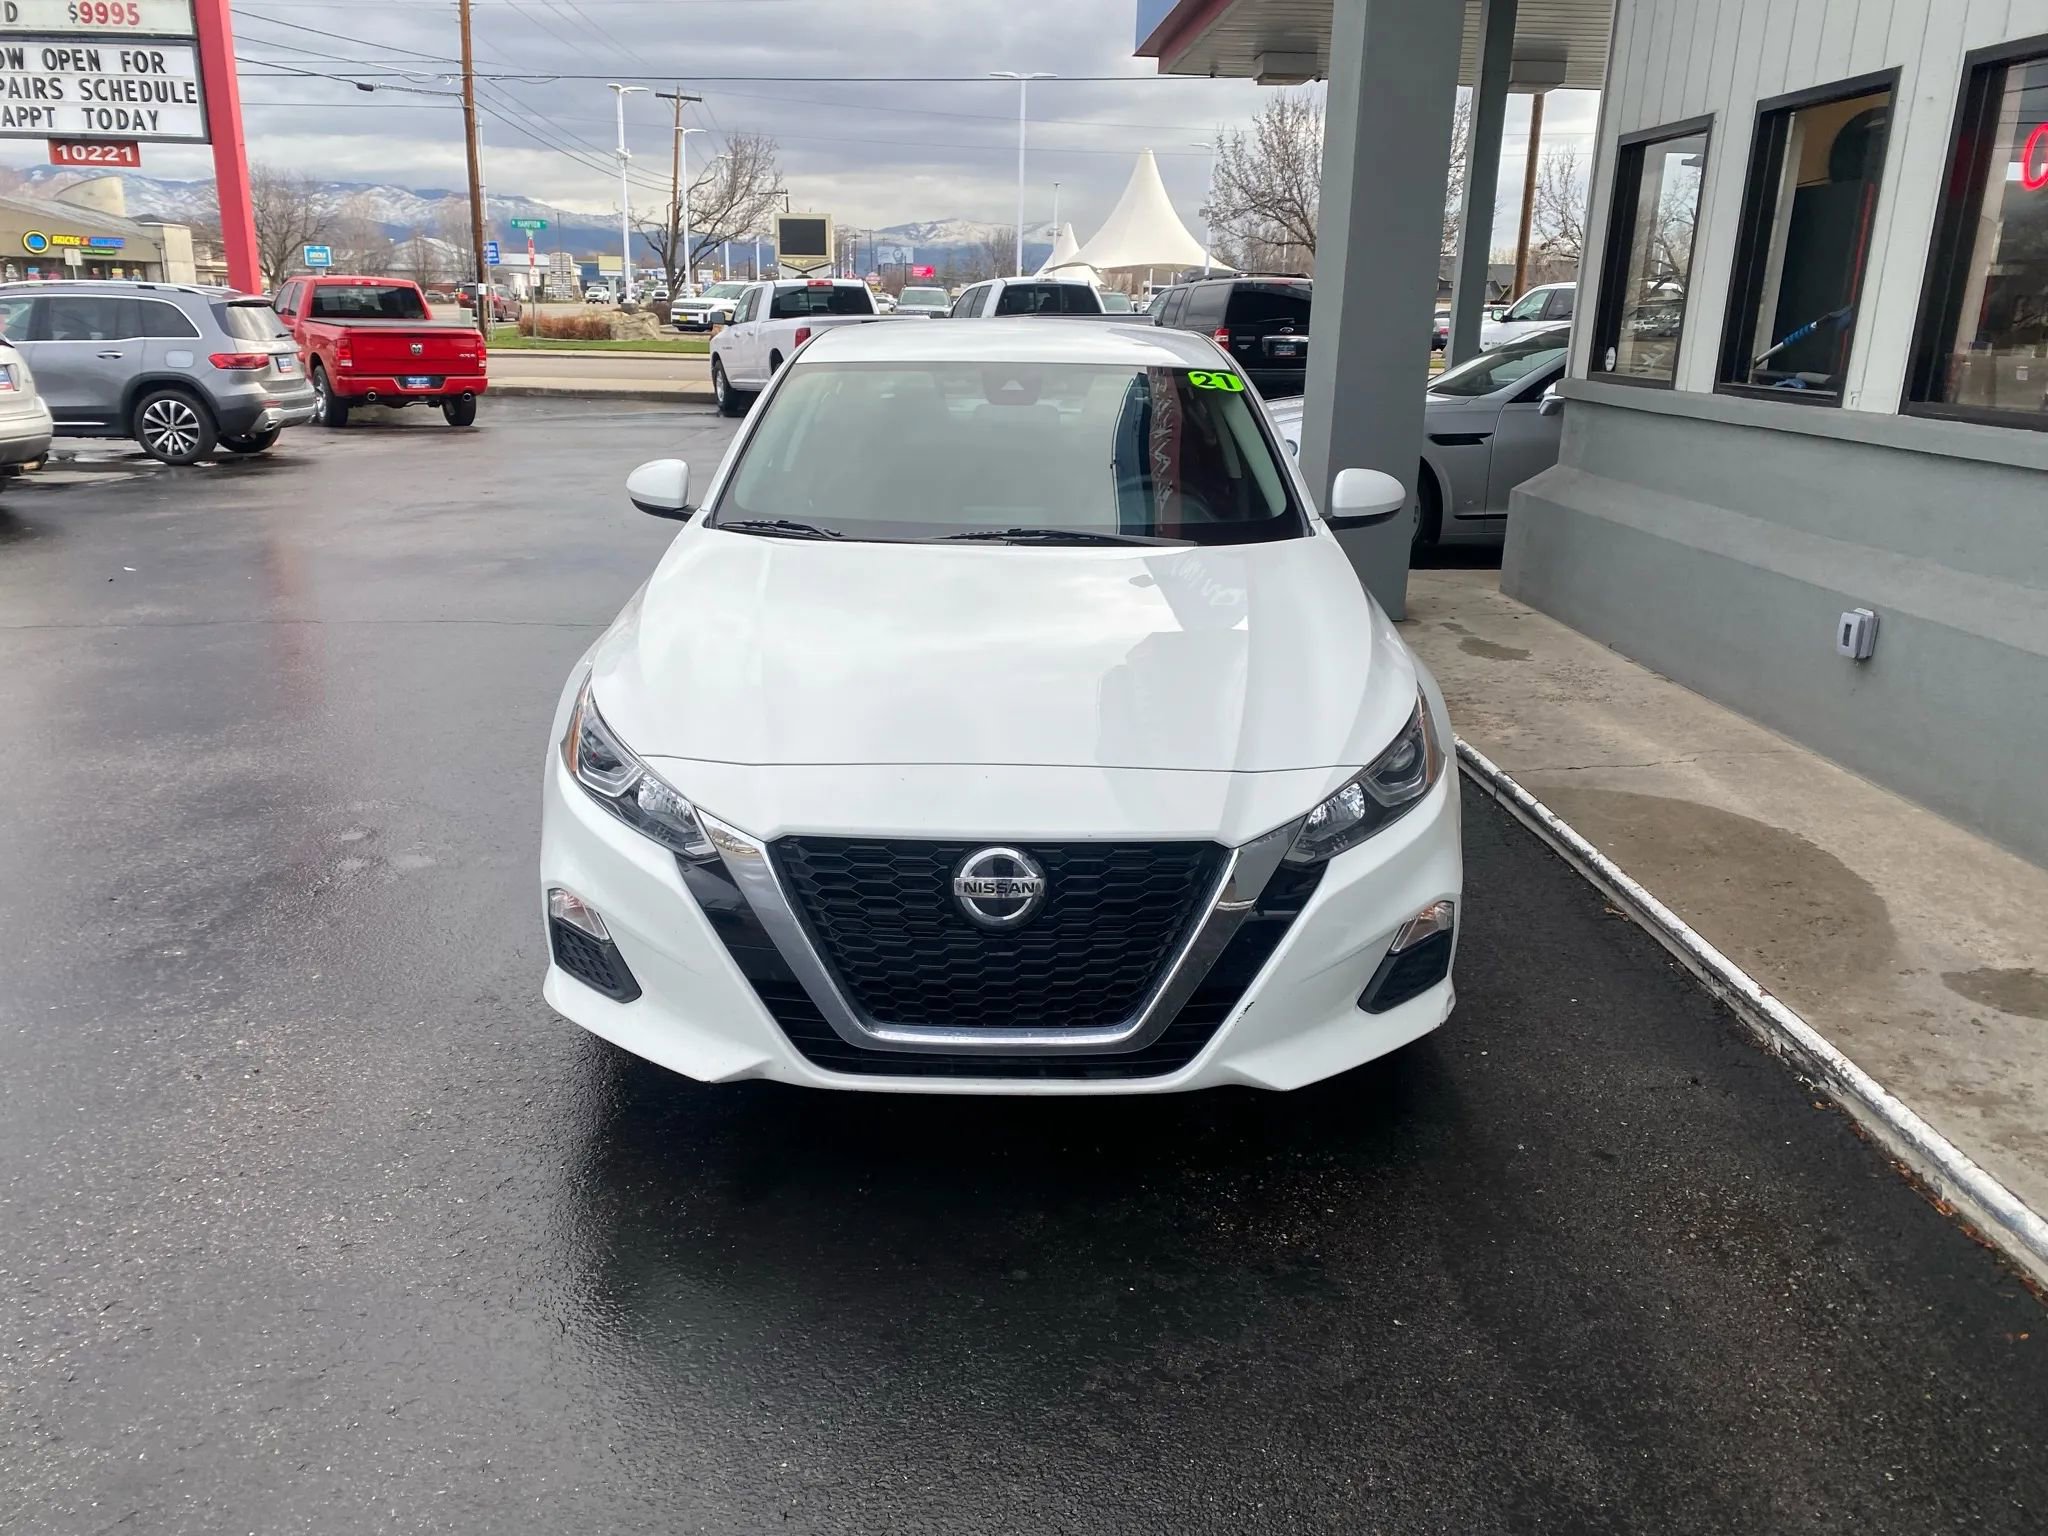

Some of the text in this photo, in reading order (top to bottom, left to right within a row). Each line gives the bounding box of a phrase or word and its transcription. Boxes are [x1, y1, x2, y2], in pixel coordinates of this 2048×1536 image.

[68, 1, 140, 26] $9995
[42, 48, 102, 72] OPEN
[120, 50, 167, 74] FOR
[78, 78, 198, 104] SCHEDULE
[2, 105, 159, 131] APPT TODAY
[57, 143, 134, 162] 10221
[51, 235, 81, 246] BRICKS
[1193, 373, 1235, 390] 21
[963, 881, 1035, 894] NISSAN
